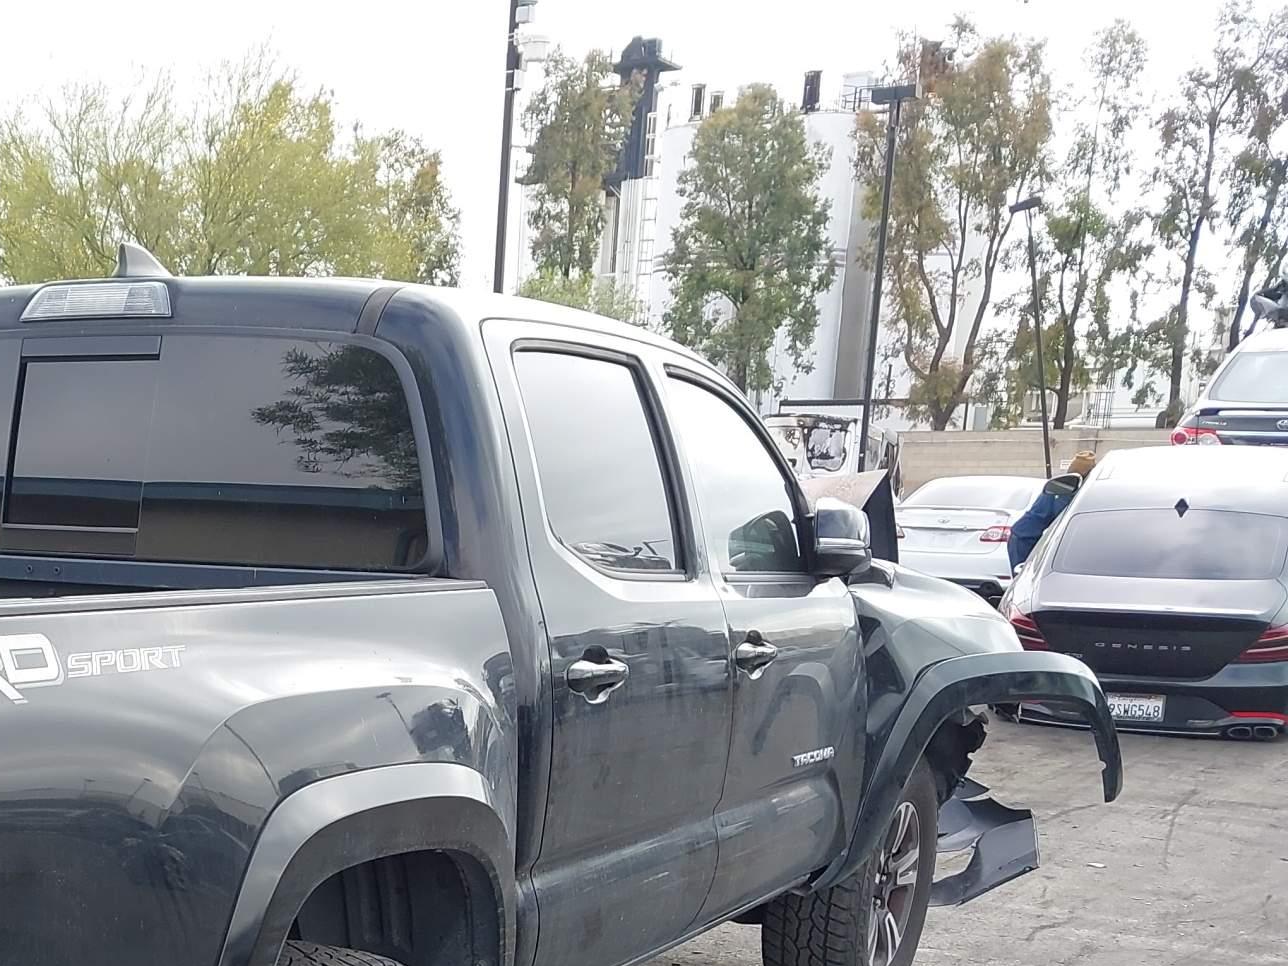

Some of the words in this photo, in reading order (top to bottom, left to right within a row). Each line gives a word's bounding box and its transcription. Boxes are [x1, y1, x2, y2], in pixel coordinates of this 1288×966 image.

[1095, 642, 1191, 651] GENESIS
[68, 645, 186, 678] SPORT
[793, 746, 835, 767] TACOMA
